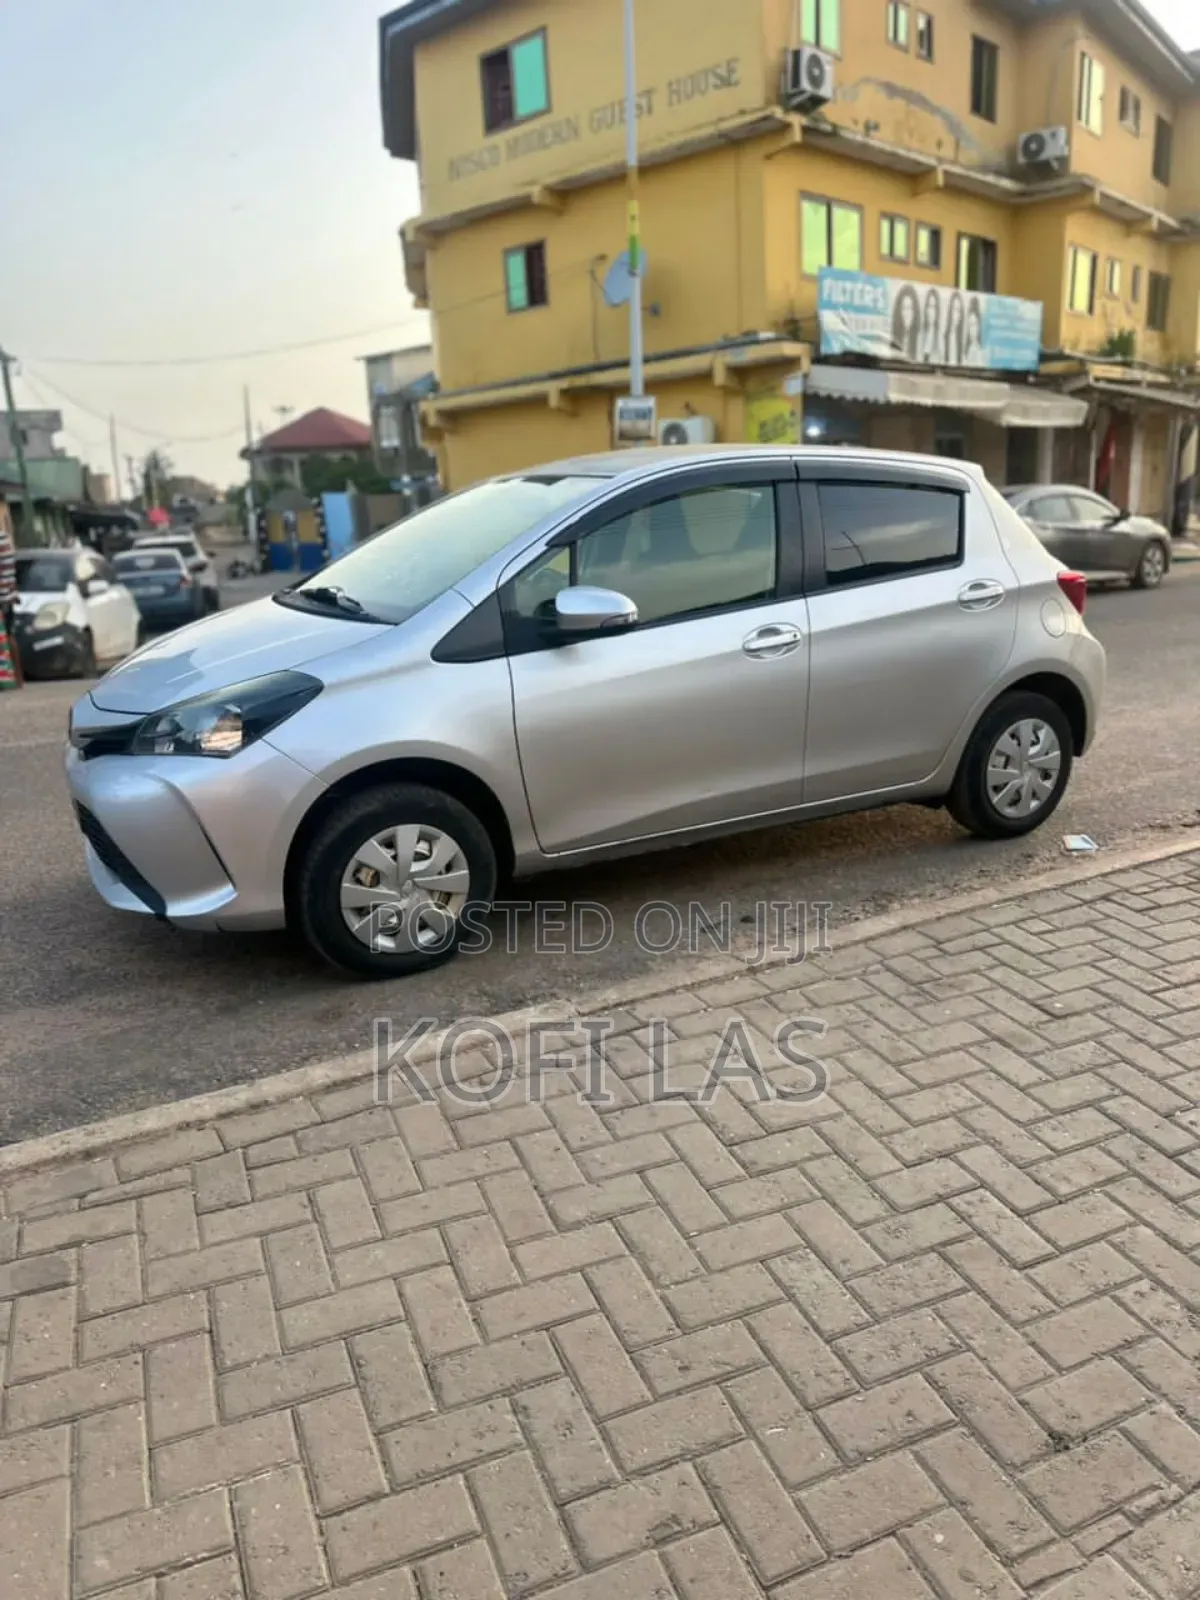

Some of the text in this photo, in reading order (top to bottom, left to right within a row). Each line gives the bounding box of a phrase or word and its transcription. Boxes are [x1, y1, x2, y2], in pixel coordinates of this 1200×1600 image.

[504, 113, 582, 162] MODERN
[589, 87, 656, 135] GUEST
[667, 57, 741, 107] HOUSE
